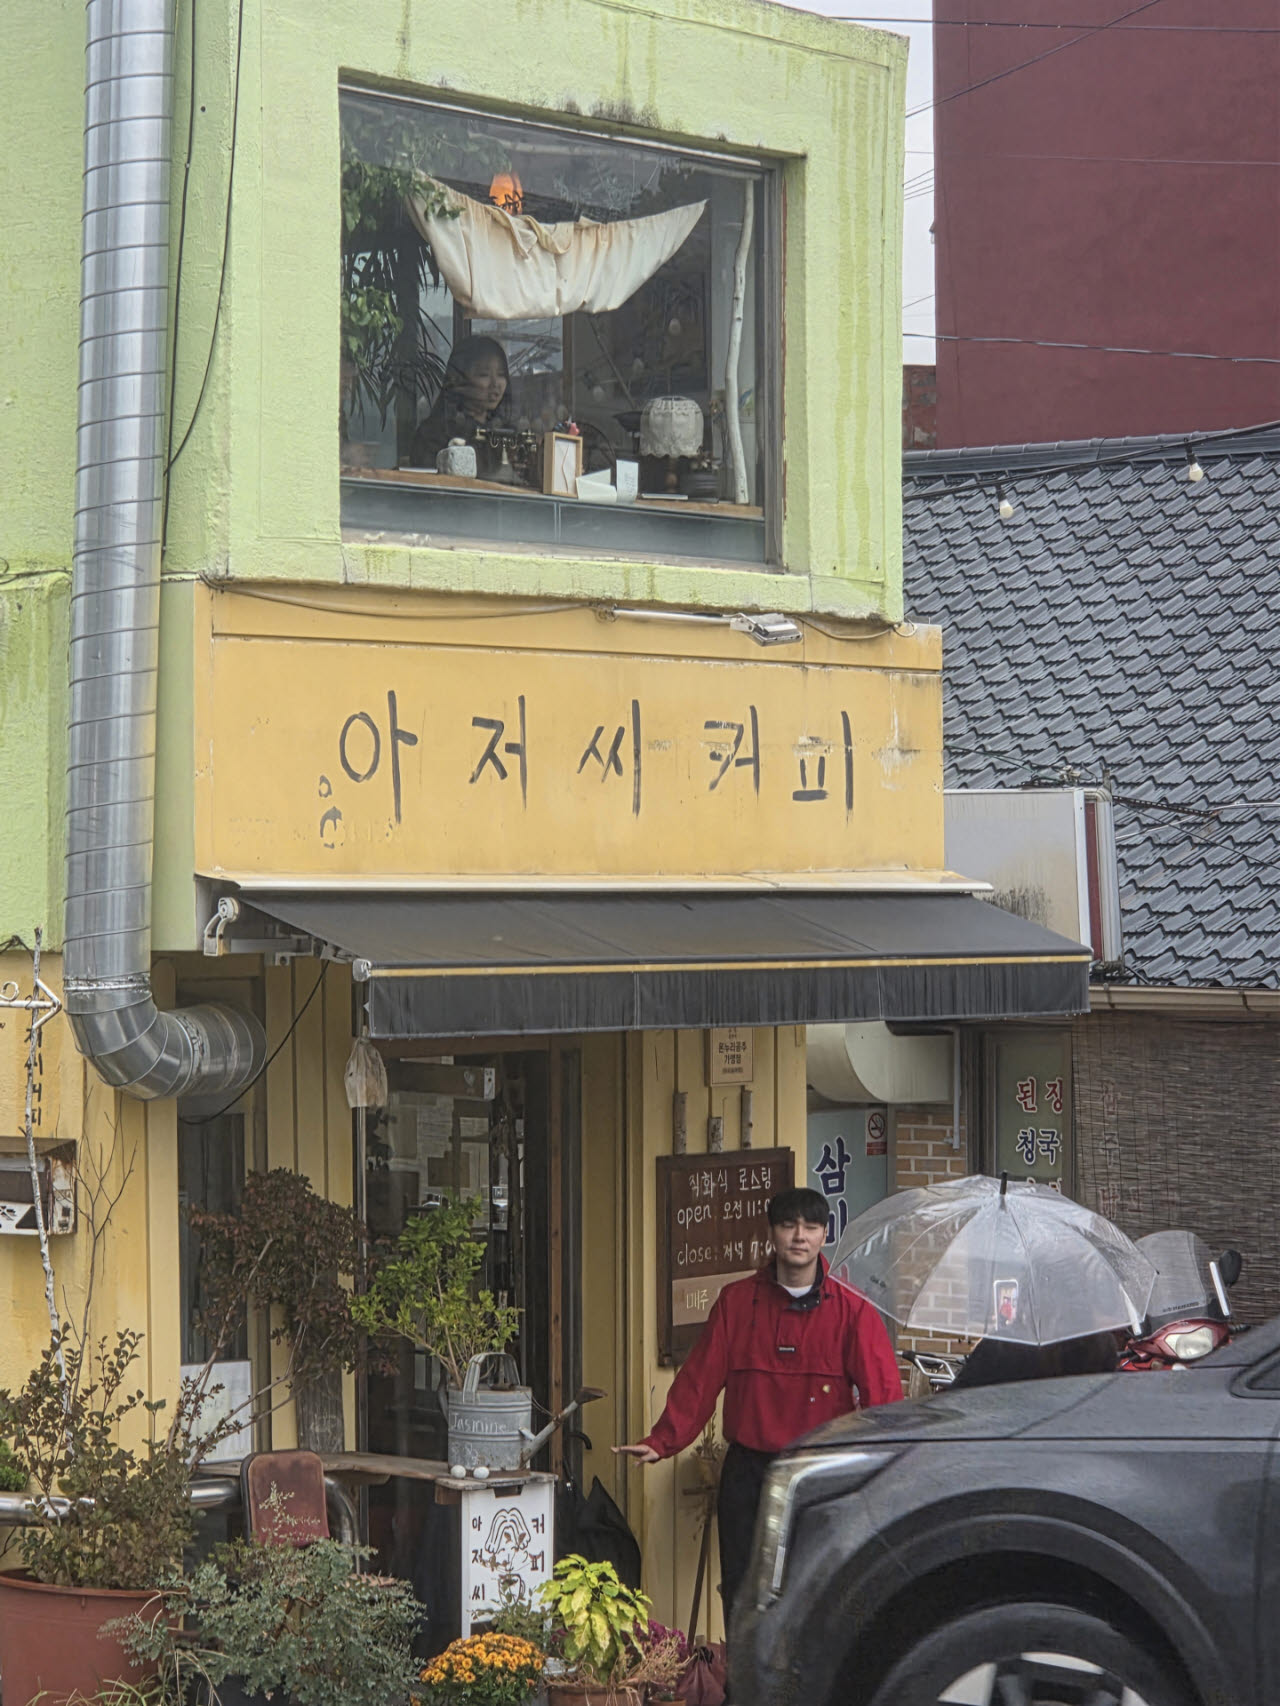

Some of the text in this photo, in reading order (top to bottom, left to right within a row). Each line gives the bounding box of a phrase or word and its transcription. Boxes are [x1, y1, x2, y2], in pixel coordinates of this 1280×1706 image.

[1016, 1127, 1062, 1165] 청국
[688, 1167, 771, 1198] 직화식 로스팅
[677, 1204, 712, 1230] open
[722, 1200, 743, 1220] 오전
[722, 1241, 743, 1262] 저녁
[686, 1289, 710, 1311] 매주
